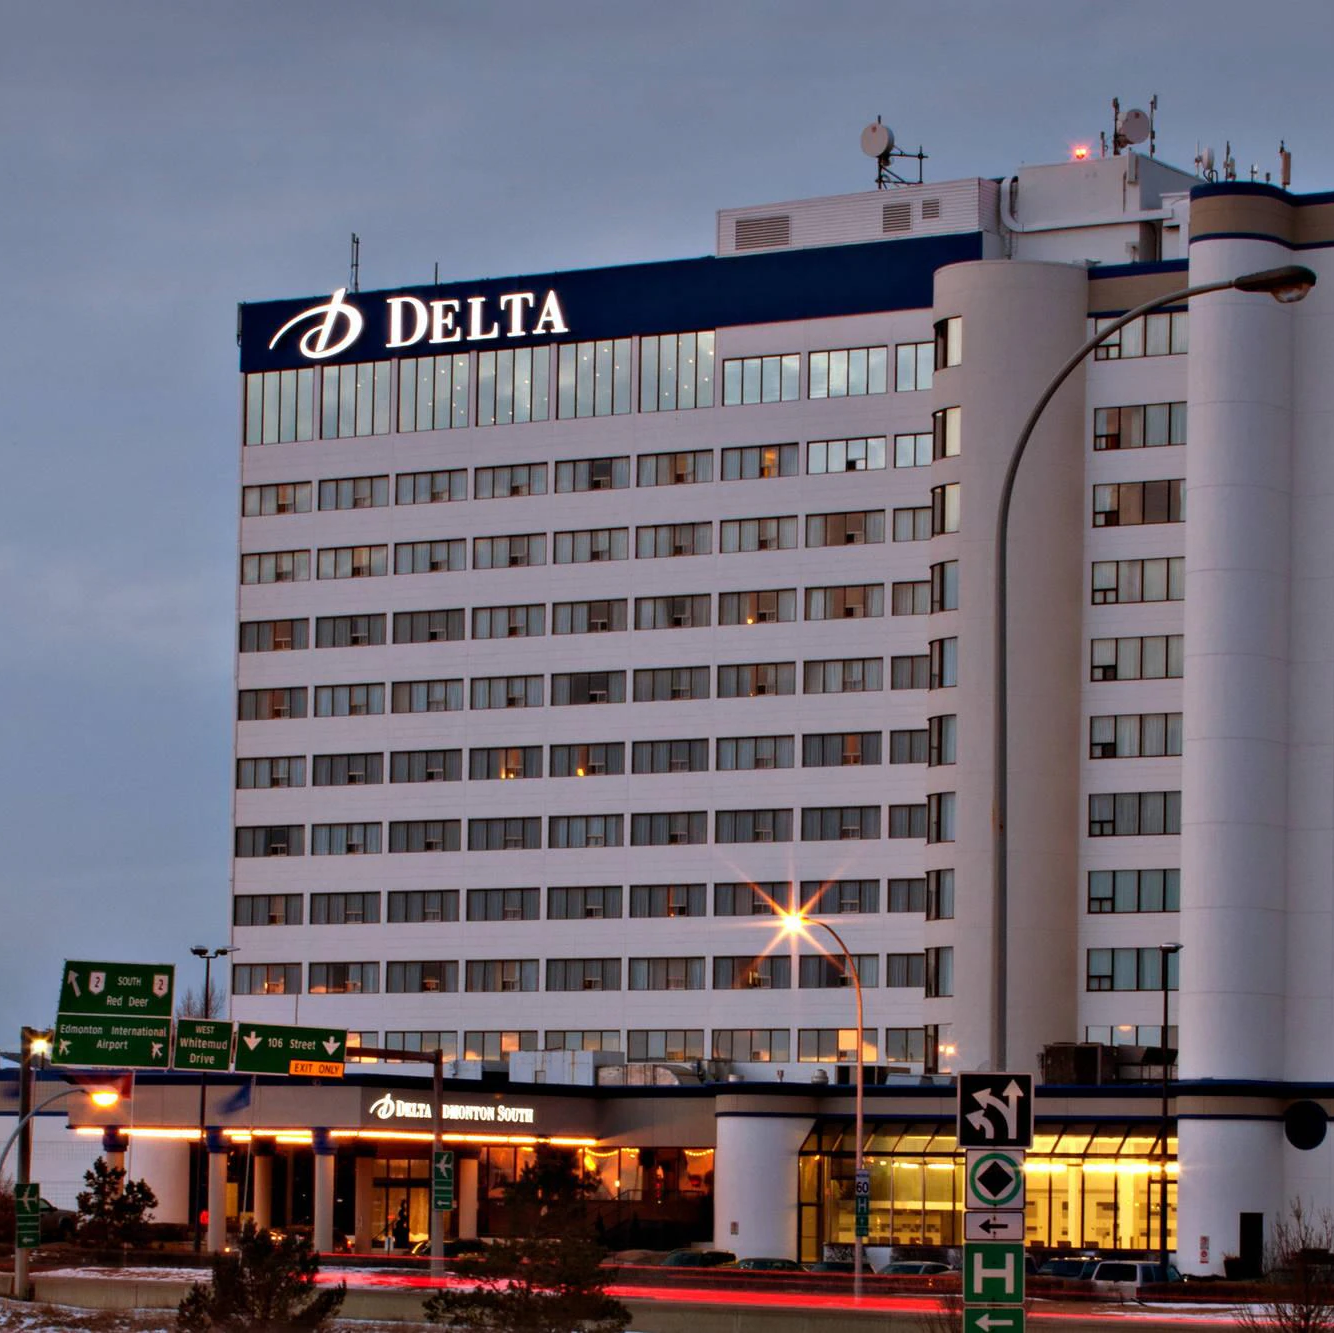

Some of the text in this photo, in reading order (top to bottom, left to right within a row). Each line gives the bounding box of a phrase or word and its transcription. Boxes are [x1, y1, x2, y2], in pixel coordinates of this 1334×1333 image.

[385, 289, 569, 348] DELTA
[94, 976, 164, 991] 2 SOUTH 2
[106, 995, 149, 1007] Red Deer
[60, 1024, 167, 1037] Edmonton International
[195, 1025, 215, 1034] WEST
[96, 1039, 128, 1051] Airport
[179, 1037, 228, 1050] Whitemud
[268, 1037, 316, 1050] 106 Street
[189, 1052, 215, 1065] Drive
[294, 1063, 340, 1075] EXIT ONLY
[395, 1100, 534, 1123] DELTA DMONTON SOUTH
[973, 1252, 1015, 1294] H
